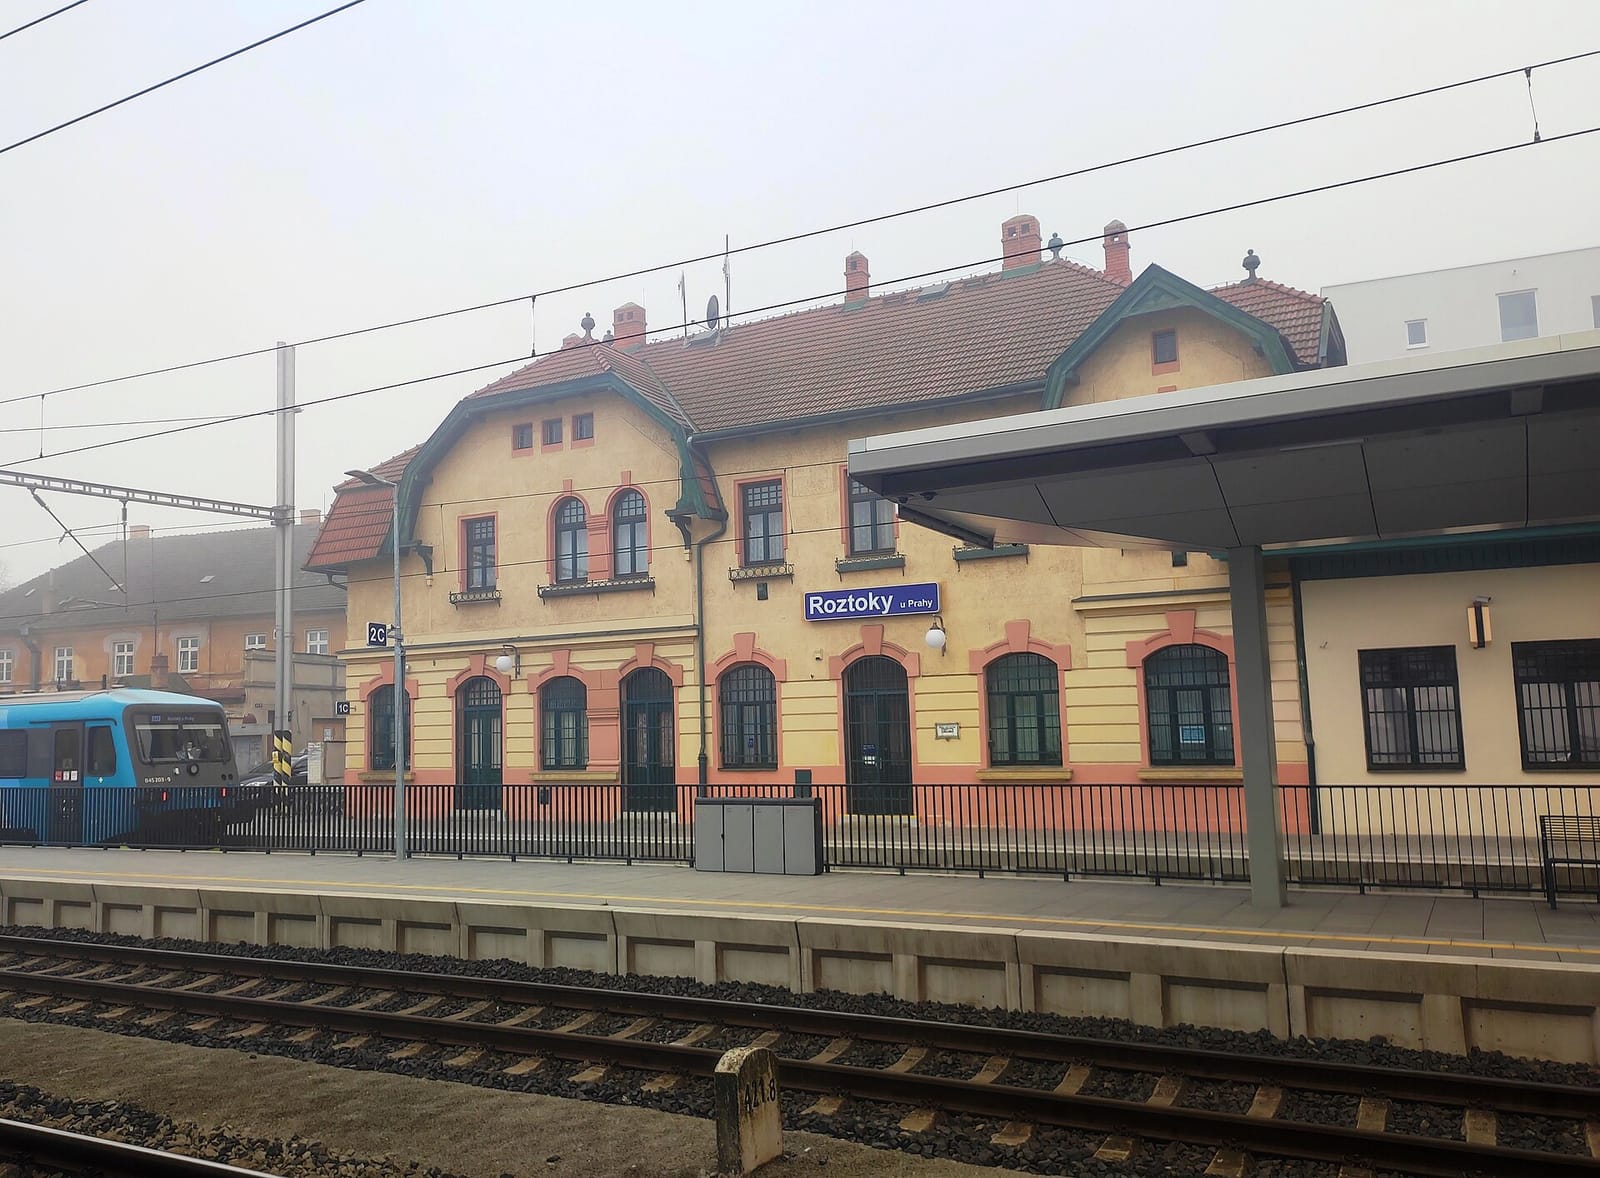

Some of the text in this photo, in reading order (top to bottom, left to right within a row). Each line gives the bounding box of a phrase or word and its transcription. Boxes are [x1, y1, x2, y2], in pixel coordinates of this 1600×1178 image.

[809, 592, 893, 614] Roztoky
[908, 598, 933, 609] Prahy
[370, 627, 385, 642] 2C
[339, 703, 349, 713] 1C
